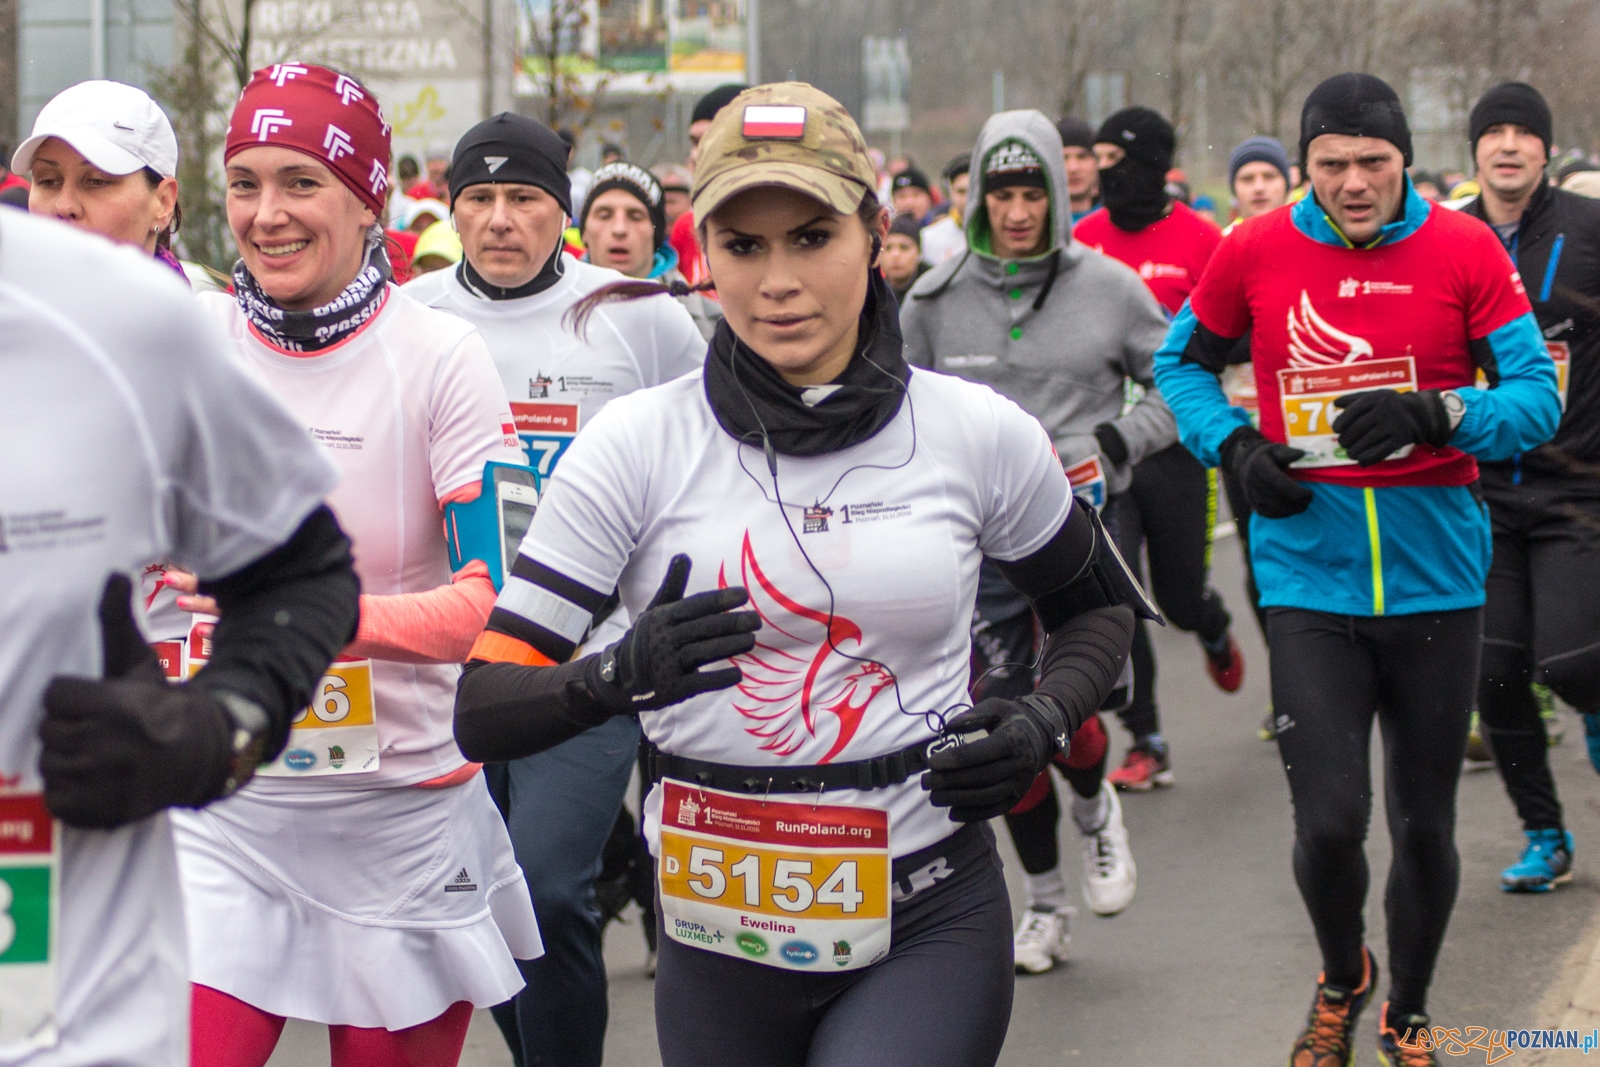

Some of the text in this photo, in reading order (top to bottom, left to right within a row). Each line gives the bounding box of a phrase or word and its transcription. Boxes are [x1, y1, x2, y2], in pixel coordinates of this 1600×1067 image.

[840, 504, 853, 525] 1
[703, 806, 714, 825] 1
[776, 821, 872, 839] RunPoland.org
[666, 845, 863, 914] D 5154
[675, 918, 707, 934] GRUPA
[740, 915, 796, 934] Ewelina
[675, 927, 713, 944] LUXMED
